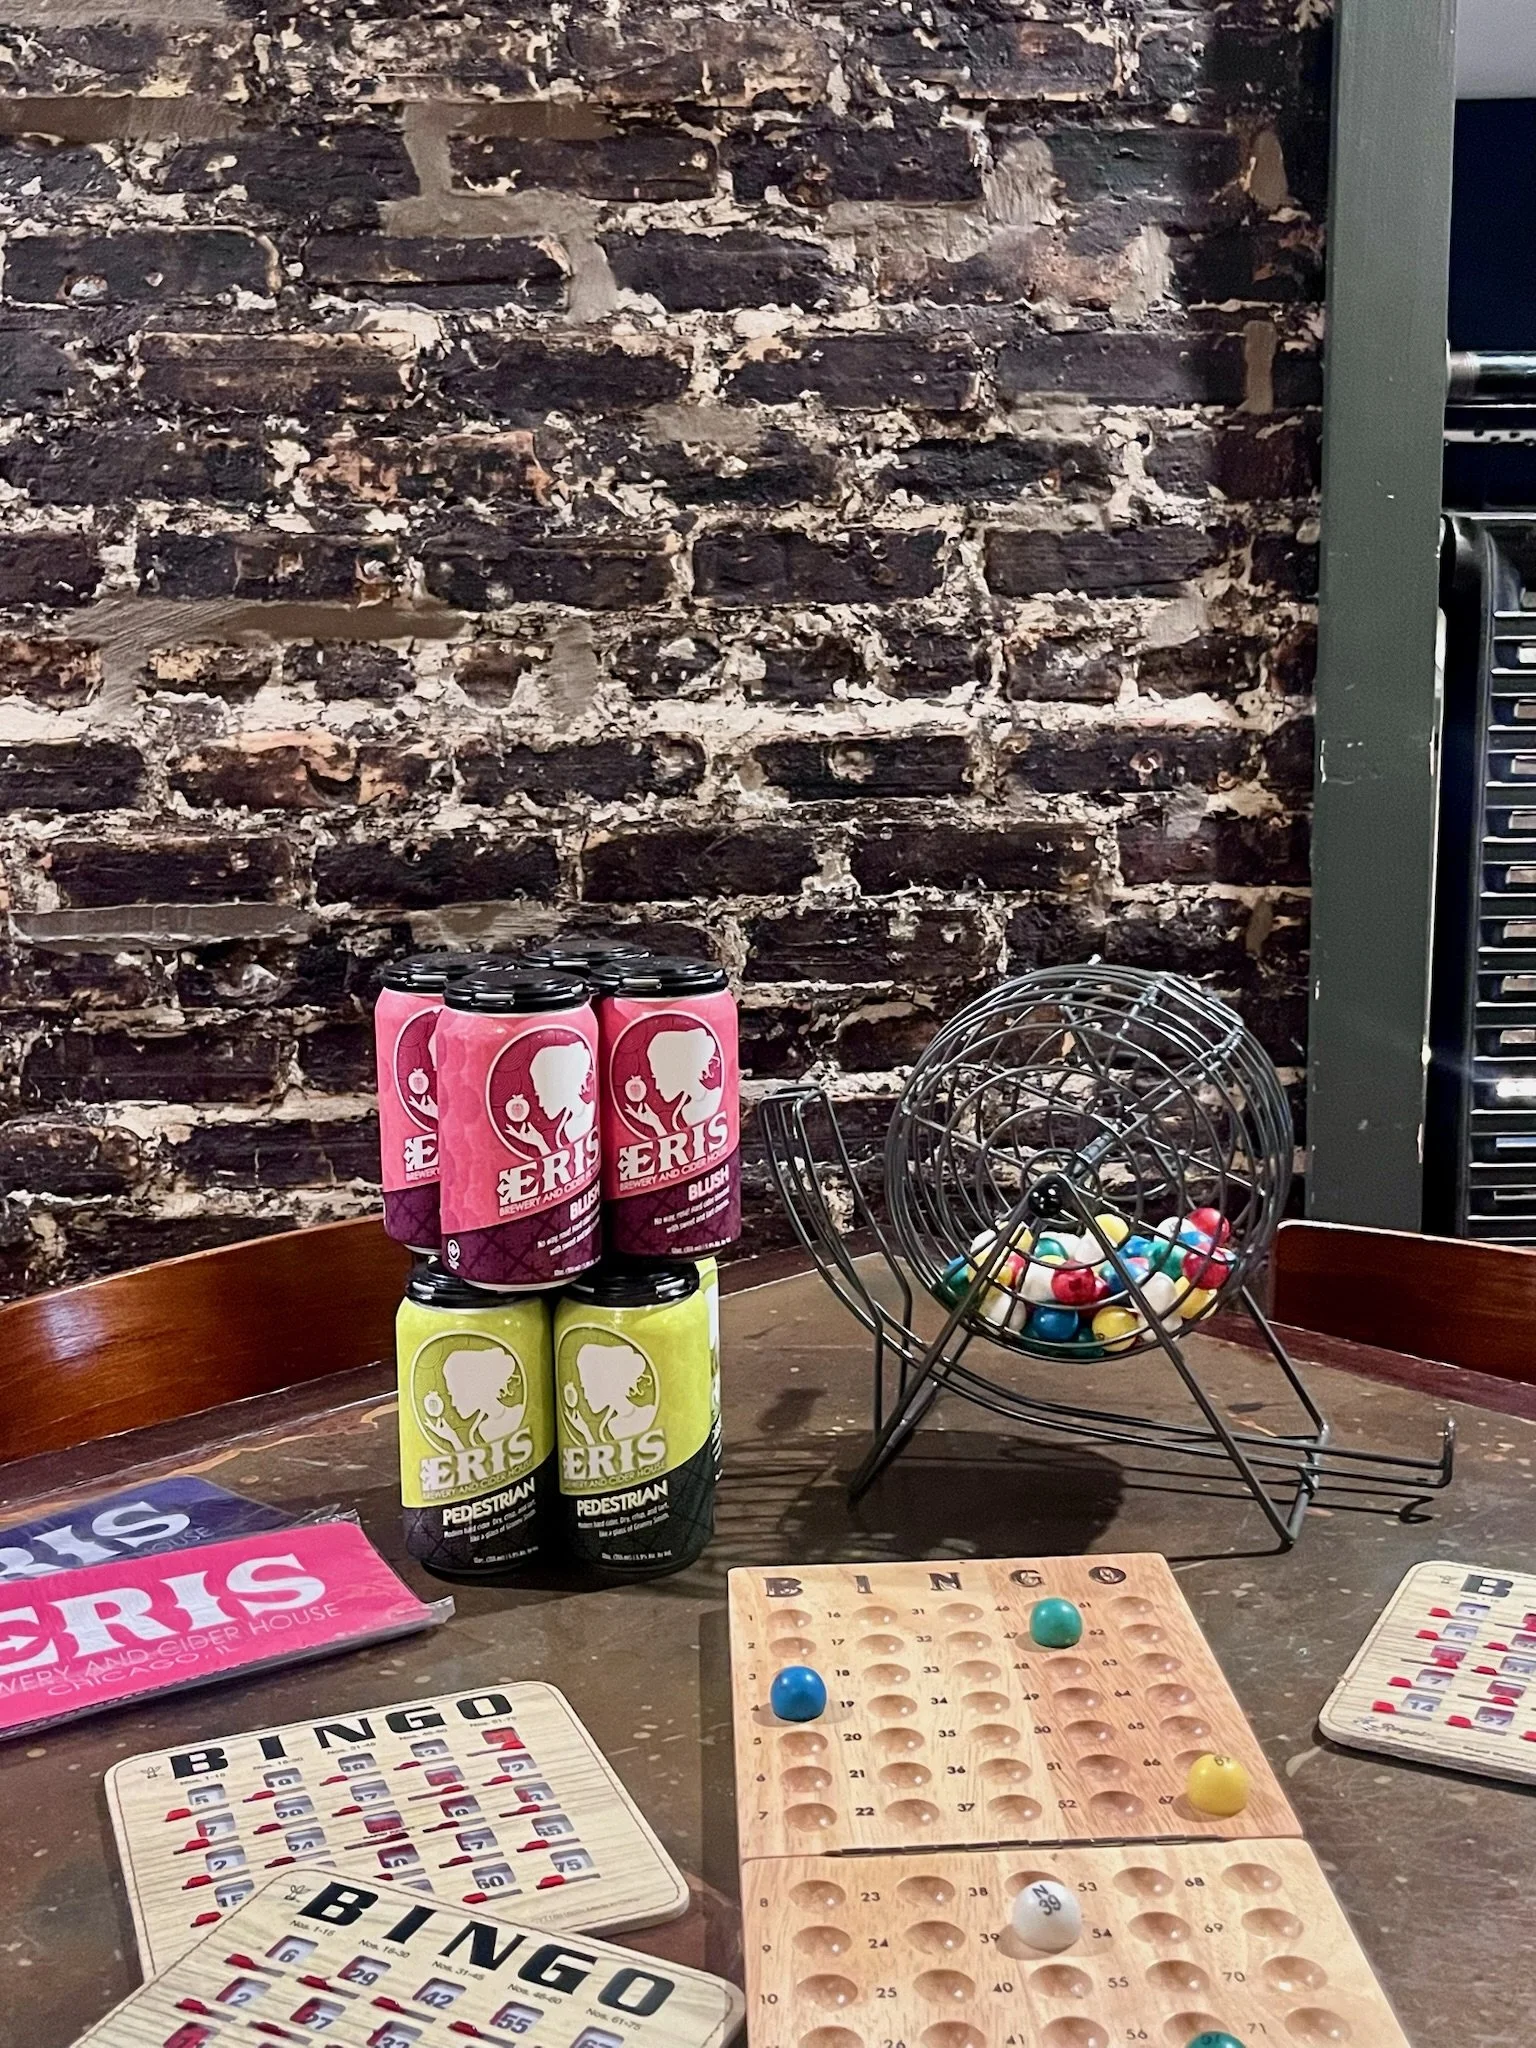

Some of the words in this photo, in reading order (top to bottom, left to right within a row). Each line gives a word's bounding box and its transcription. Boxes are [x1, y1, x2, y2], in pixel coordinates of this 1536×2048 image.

[618, 1111, 728, 1181] ERIS
[497, 1126, 600, 1206] ERIS
[620, 1174, 657, 1191] BREWERY
[659, 1168, 680, 1182] AND
[688, 1164, 729, 1201] BLUSH
[499, 1194, 541, 1217] BREWERY
[544, 1187, 563, 1202] AND
[419, 1426, 533, 1491] ERIS
[562, 1428, 666, 1480] ERIS
[589, 1478, 607, 1487] AND
[608, 1472, 635, 1486] CIDER
[636, 1462, 666, 1476] HOUSE
[460, 1482, 479, 1494] AND
[480, 1473, 506, 1488] CIDER
[442, 1477, 536, 1526] PEDESTRIAN
[576, 1479, 669, 1517] PEDESTRIAN
[84, 1649, 149, 1678] AND
[157, 1626, 239, 1657] CIDER
[249, 1602, 342, 1636] HOUSE
[214, 1645, 234, 1656] IL
[1014, 1662, 1030, 1670] 48
[931, 1697, 948, 1705] 34
[1410, 1701, 1434, 1712] 14
[1034, 1726, 1050, 1734] 50
[843, 1733, 862, 1741] 20
[947, 1766, 965, 1774] 36
[1047, 1762, 1062, 1770] 51
[756, 1774, 765, 1782] 6
[850, 1770, 865, 1778] 21
[1059, 1800, 1076, 1808] 52
[1159, 1796, 1174, 1804] 67
[856, 1808, 874, 1816] 22
[958, 1803, 975, 1812] 37
[759, 1811, 768, 1820] 7
[555, 1858, 582, 1872] 75
[477, 1875, 504, 1889] 60
[1078, 1881, 1098, 1892] 53
[1184, 1878, 1205, 1887] 68
[861, 1892, 880, 1901] 23
[968, 1887, 988, 1896] 38
[1032, 1884, 1049, 1898] N
[760, 1898, 769, 1907] 8
[1039, 1894, 1062, 1916] 39
[1092, 1928, 1113, 1939] 54
[1204, 1923, 1223, 1933] 69
[868, 1939, 888, 1948] 24
[980, 1933, 1000, 1943] 39
[297, 1881, 675, 2017] BINGO
[358, 1938, 379, 1950] Nos.
[762, 1944, 771, 1953] 9
[278, 1948, 300, 1963] 6
[432, 1960, 453, 1973] Nos.
[455, 1968, 486, 1981] 31-45
[349, 1968, 379, 1986] 29
[1108, 1977, 1129, 1988] 55
[1222, 1972, 1245, 1982] 70
[507, 1983, 529, 1996] Nos.
[876, 1988, 897, 1998] 25
[992, 1983, 1013, 1993] 40
[230, 1992, 252, 2008] 2
[420, 1991, 454, 2010] 42
[760, 1994, 778, 2004] 10
[496, 2014, 532, 2034] 55
[586, 2007, 608, 2021] Nos.
[611, 2015, 642, 2031] 61-75
[1247, 2024, 1266, 2034] 71
[1006, 2034, 1024, 2045] 41
[1126, 2030, 1148, 2040] 56
